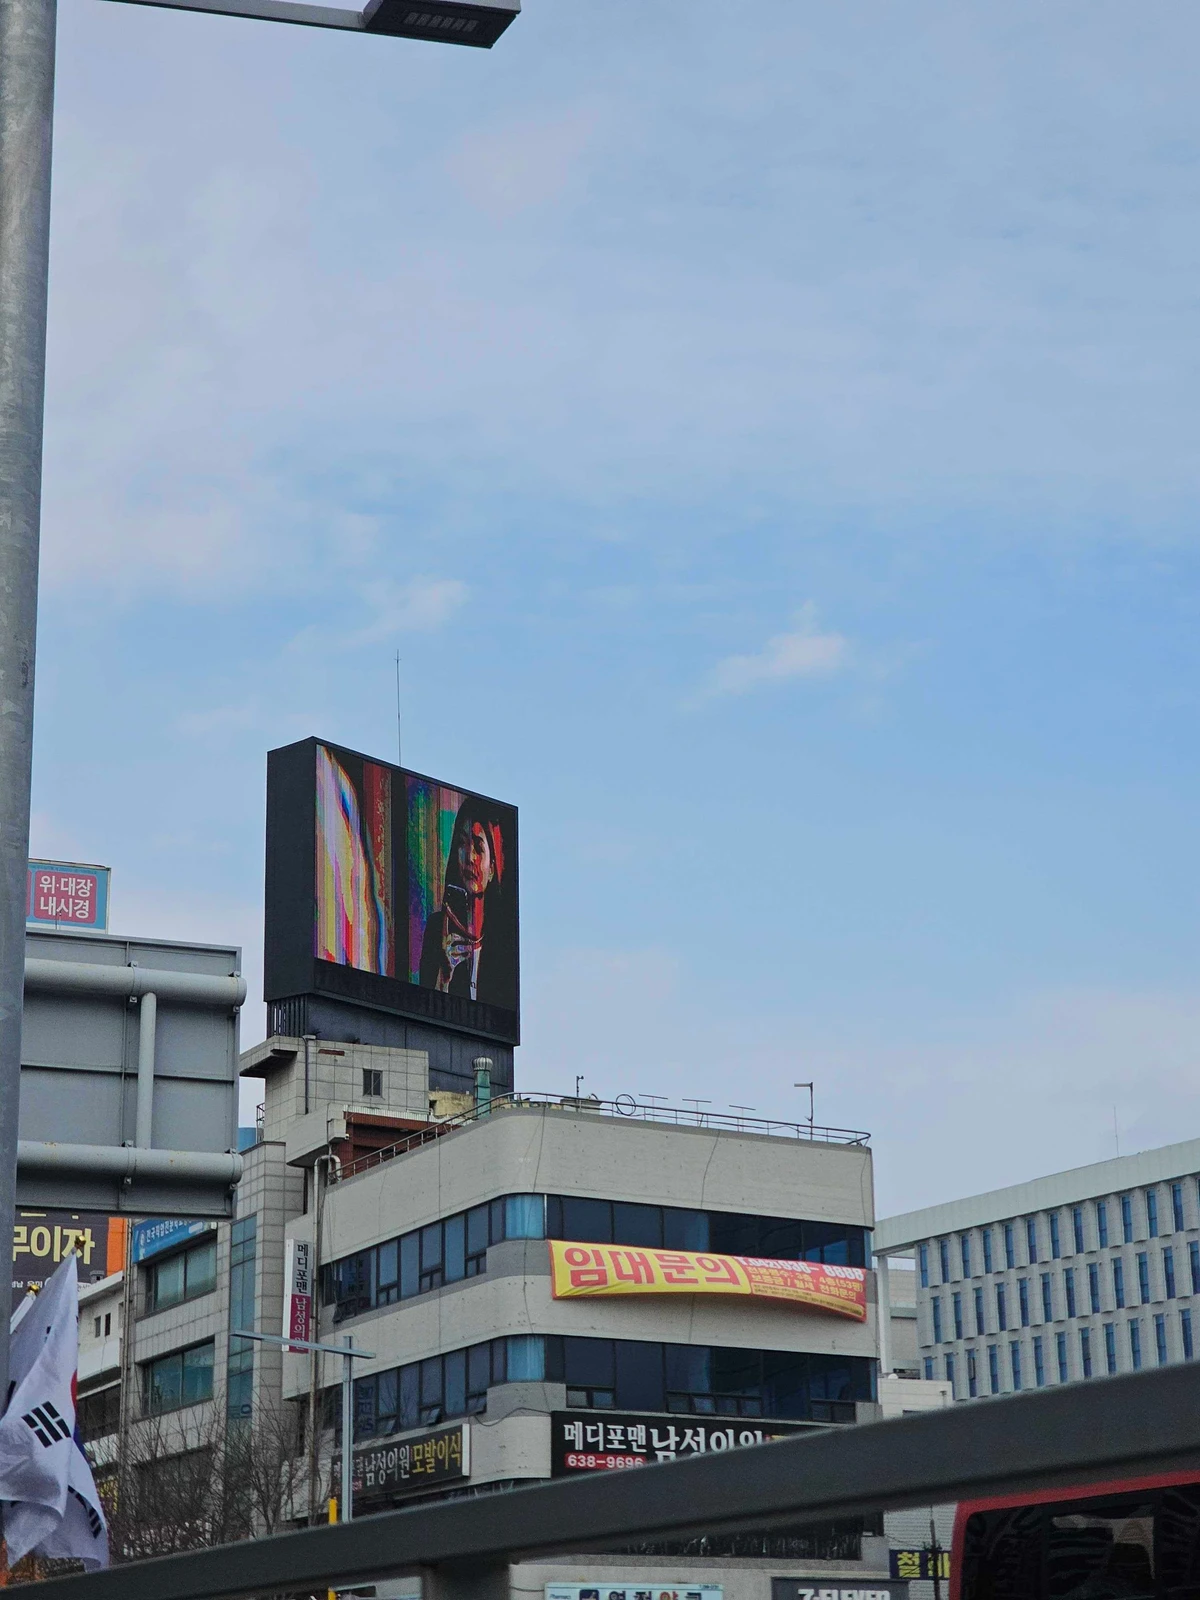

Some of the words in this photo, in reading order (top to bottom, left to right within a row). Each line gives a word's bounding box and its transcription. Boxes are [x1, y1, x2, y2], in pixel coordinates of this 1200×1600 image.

[39, 897, 90, 919] 내시경
[563, 1247, 742, 1288] 임대문의
[563, 1421, 648, 1453] 메디포맨
[364, 1444, 411, 1487] 남성의원
[412, 1431, 462, 1475] 모발이식
[567, 1454, 645, 1469] 638-9696
